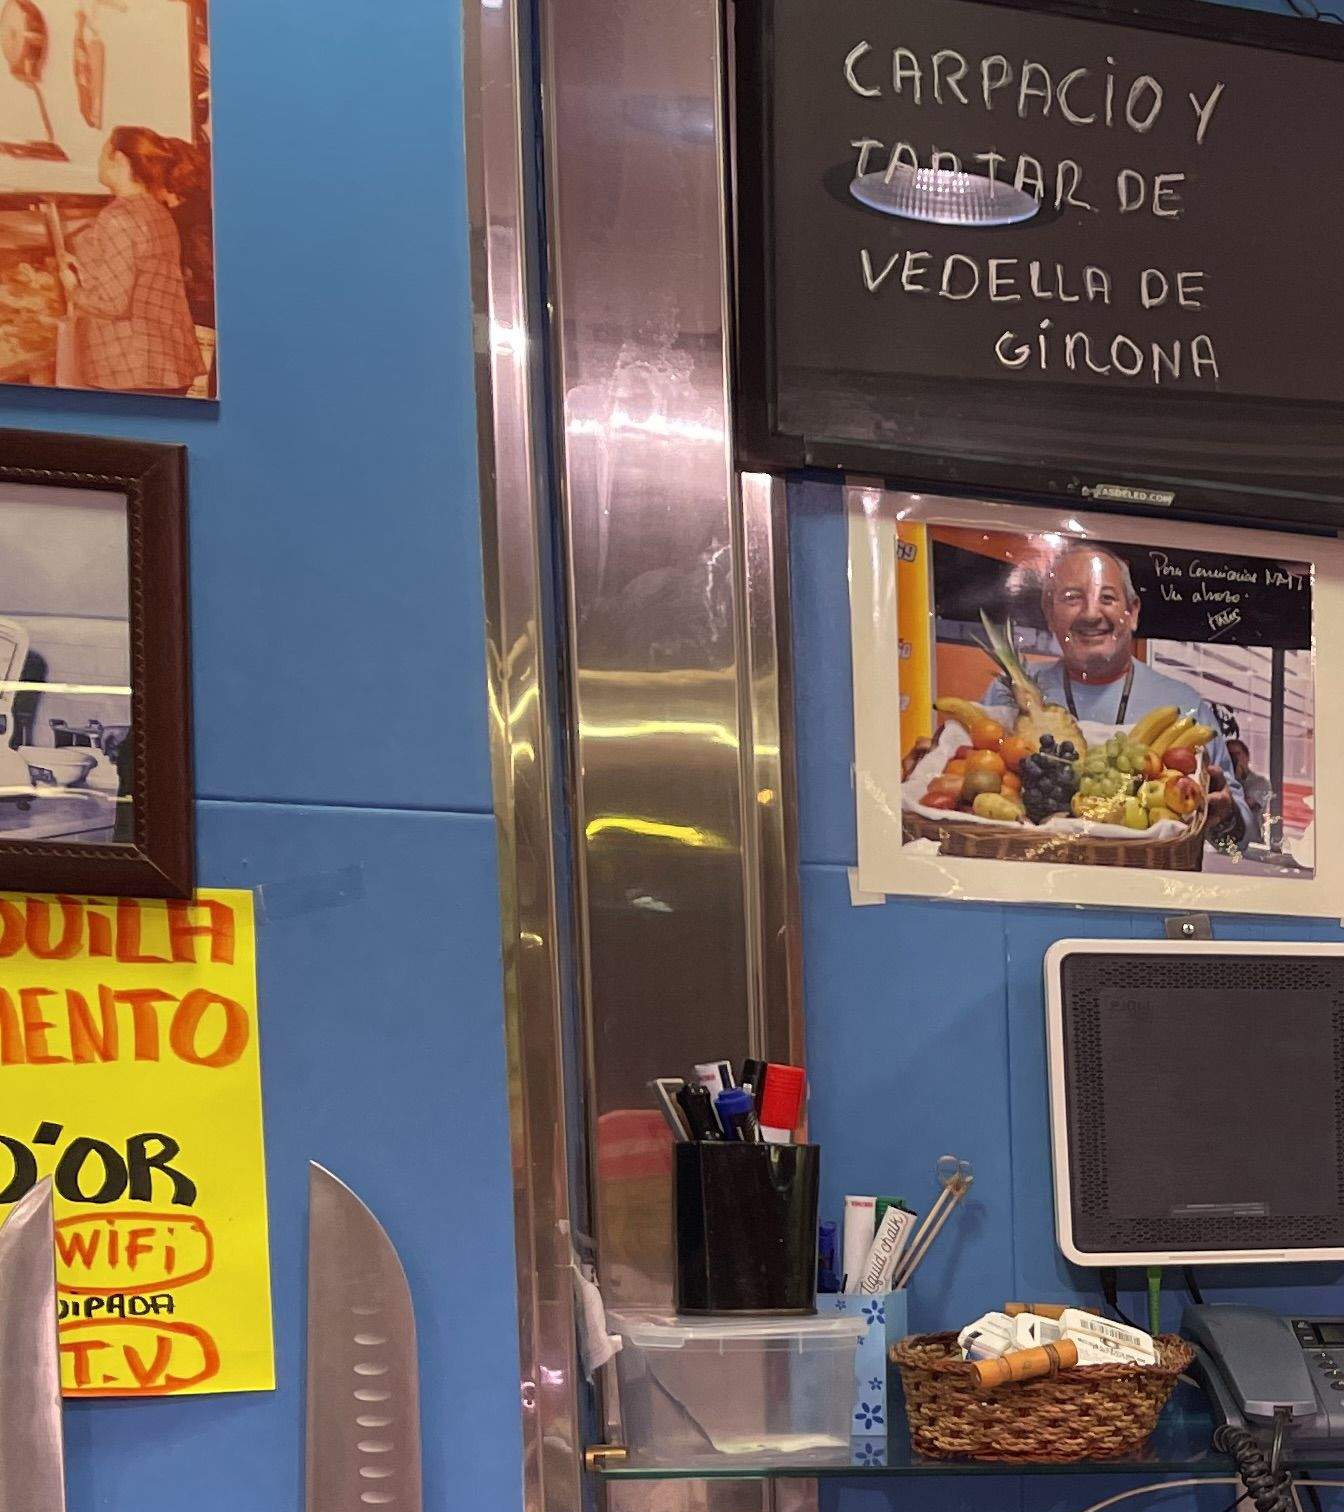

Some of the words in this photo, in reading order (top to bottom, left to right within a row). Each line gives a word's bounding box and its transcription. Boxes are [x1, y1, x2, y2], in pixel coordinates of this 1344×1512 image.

[1118, 171, 1185, 217] DE
[861, 249, 1110, 303] VEDELLA
[1140, 270, 1204, 308] DE
